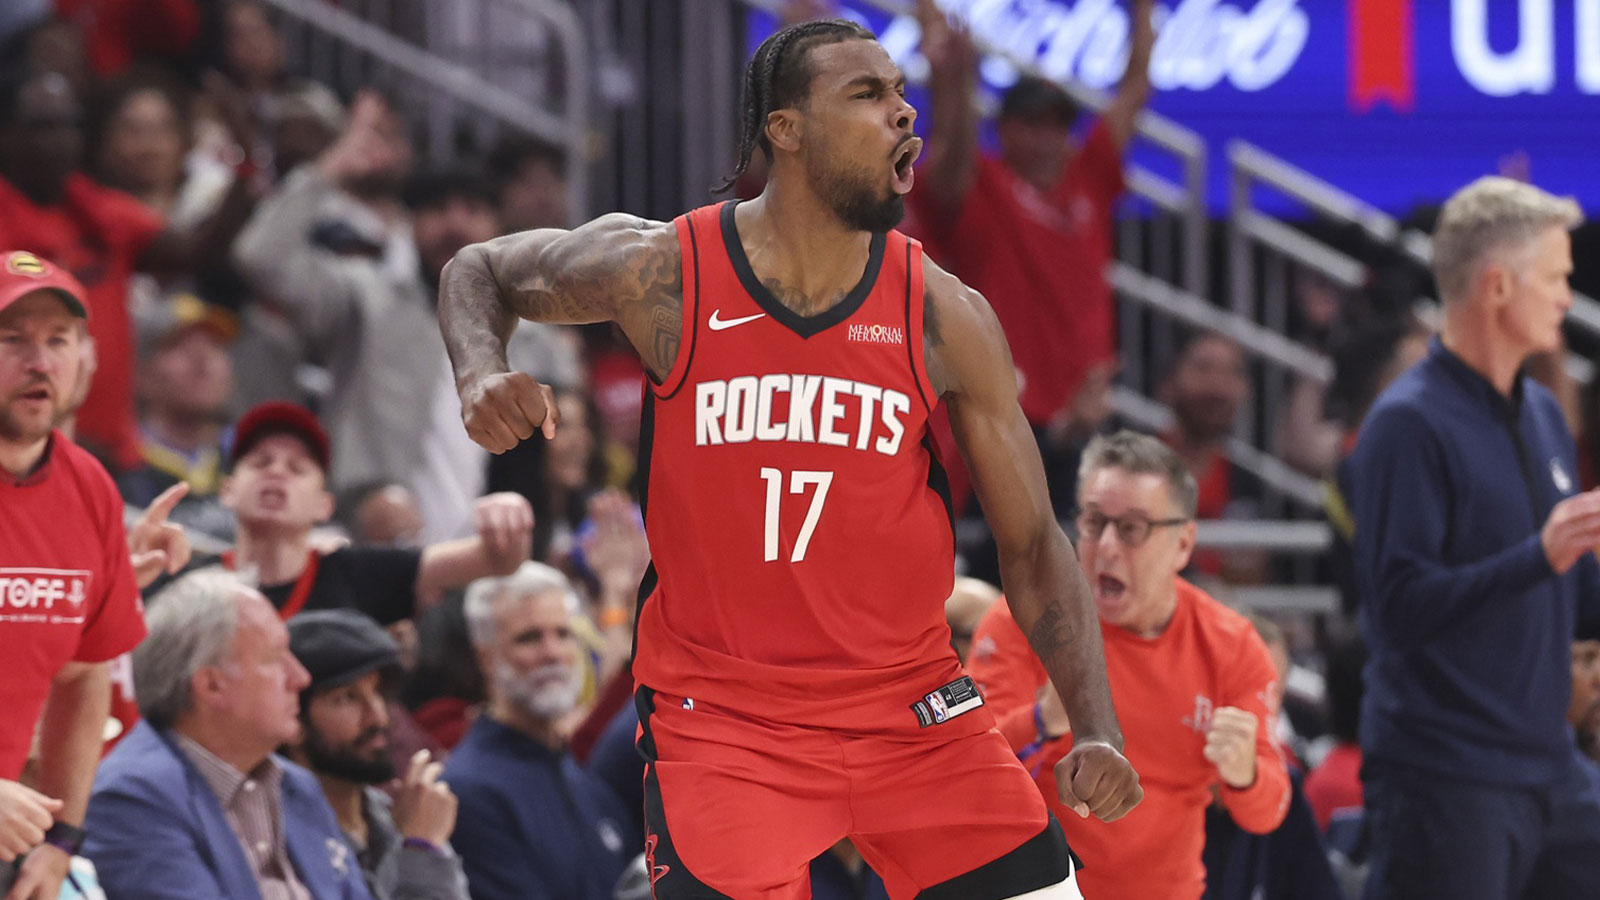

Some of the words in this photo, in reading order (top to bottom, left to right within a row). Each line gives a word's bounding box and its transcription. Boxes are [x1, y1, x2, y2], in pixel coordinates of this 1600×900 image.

[848, 331, 903, 344] HERMANN
[849, 324, 903, 337] MEMORIAL
[695, 374, 910, 456] ROCKETS
[760, 467, 834, 563] 17
